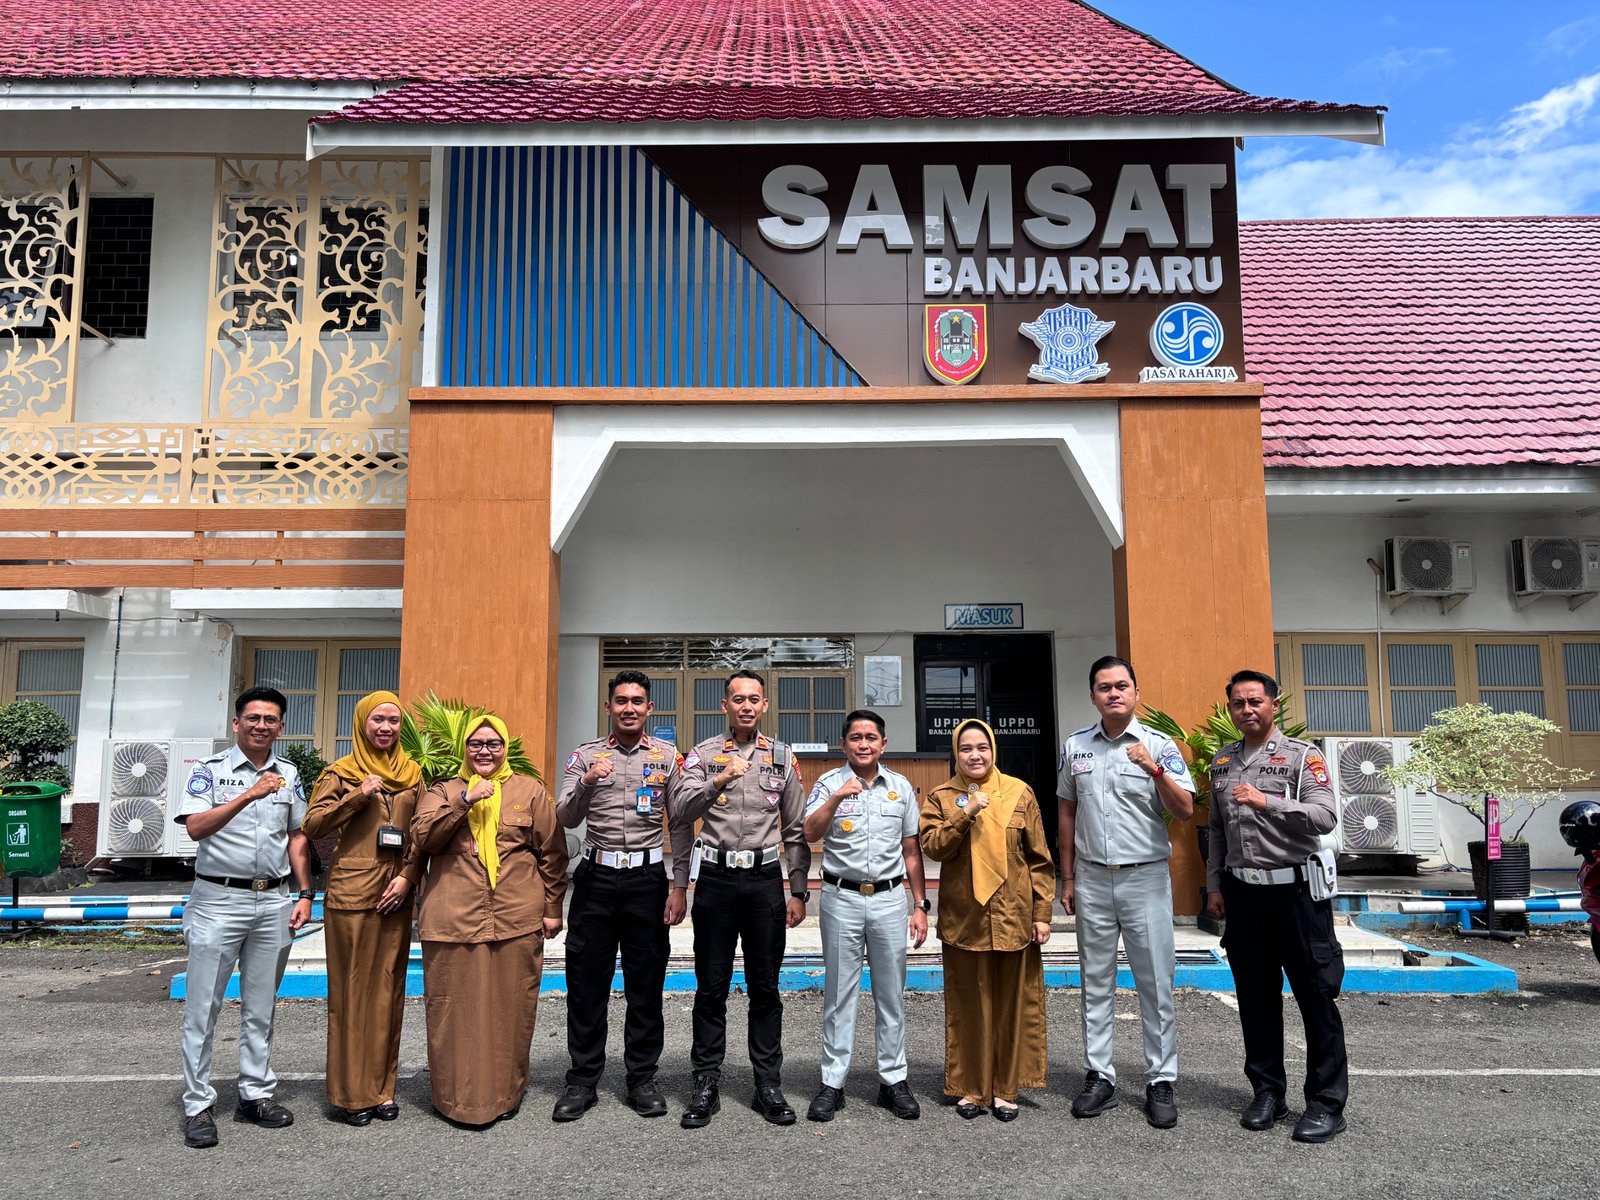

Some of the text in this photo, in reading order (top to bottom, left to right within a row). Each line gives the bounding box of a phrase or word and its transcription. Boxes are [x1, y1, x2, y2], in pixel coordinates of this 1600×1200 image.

[757, 164, 1228, 250] SAMSAT
[923, 256, 1223, 296] BANJARBARU
[1146, 368, 1236, 381] JASA RAHARJA
[954, 608, 1013, 625] MASUK
[933, 717, 966, 729] UPP
[999, 717, 1035, 728] UPPD
[1073, 752, 1094, 760] RIKO
[643, 763, 668, 771] POLRI
[760, 766, 785, 776] POLRI
[1260, 767, 1289, 776] POLRI
[219, 778, 245, 787] RIZA
